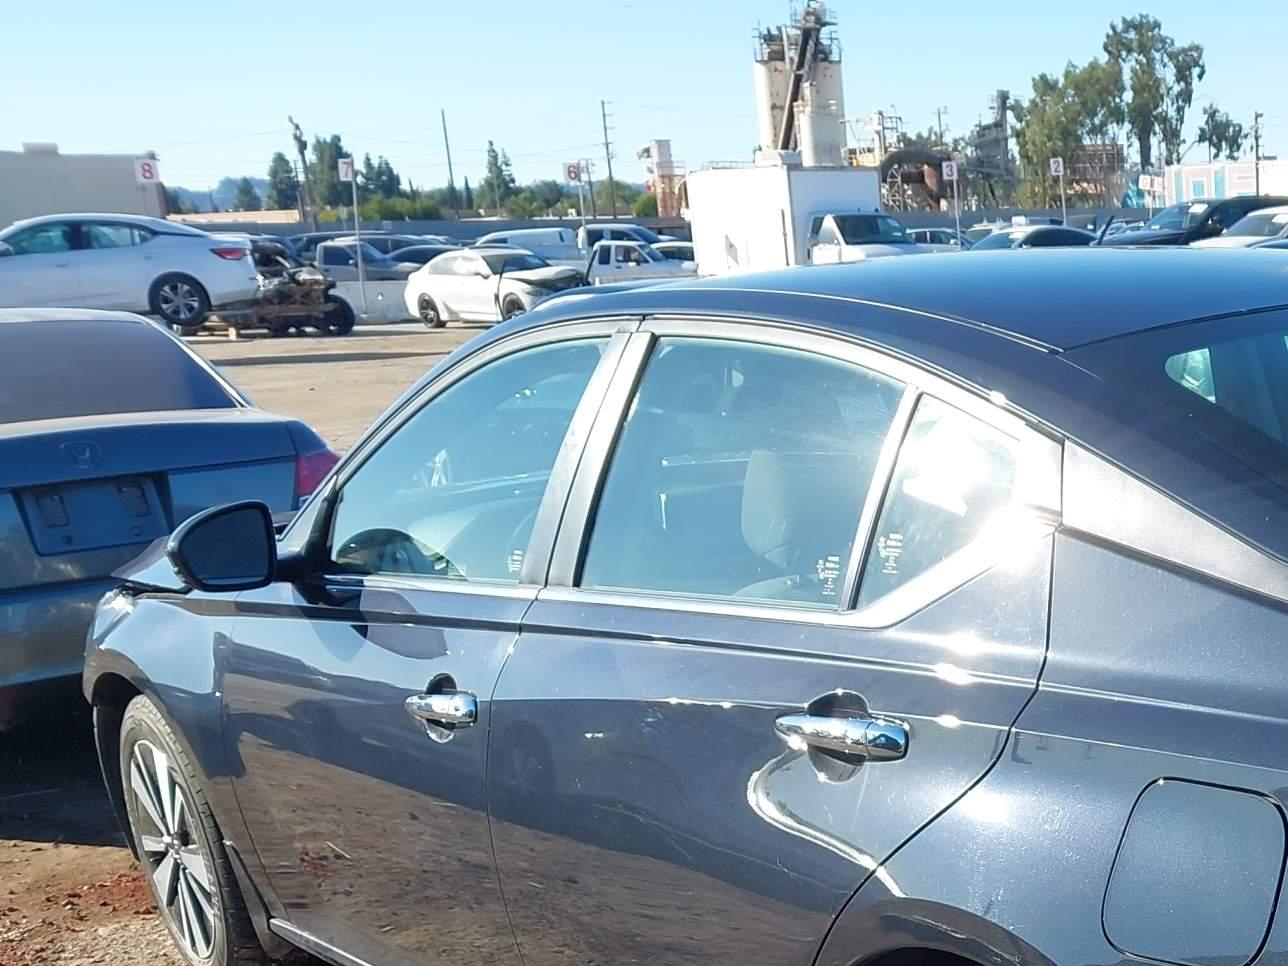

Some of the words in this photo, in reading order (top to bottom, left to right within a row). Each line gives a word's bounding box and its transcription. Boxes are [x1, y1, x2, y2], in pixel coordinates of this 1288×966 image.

[141, 162, 154, 180] 8
[341, 161, 351, 179] 7
[567, 165, 578, 180] 6
[945, 163, 955, 178] 3
[1052, 159, 1062, 174] 2
